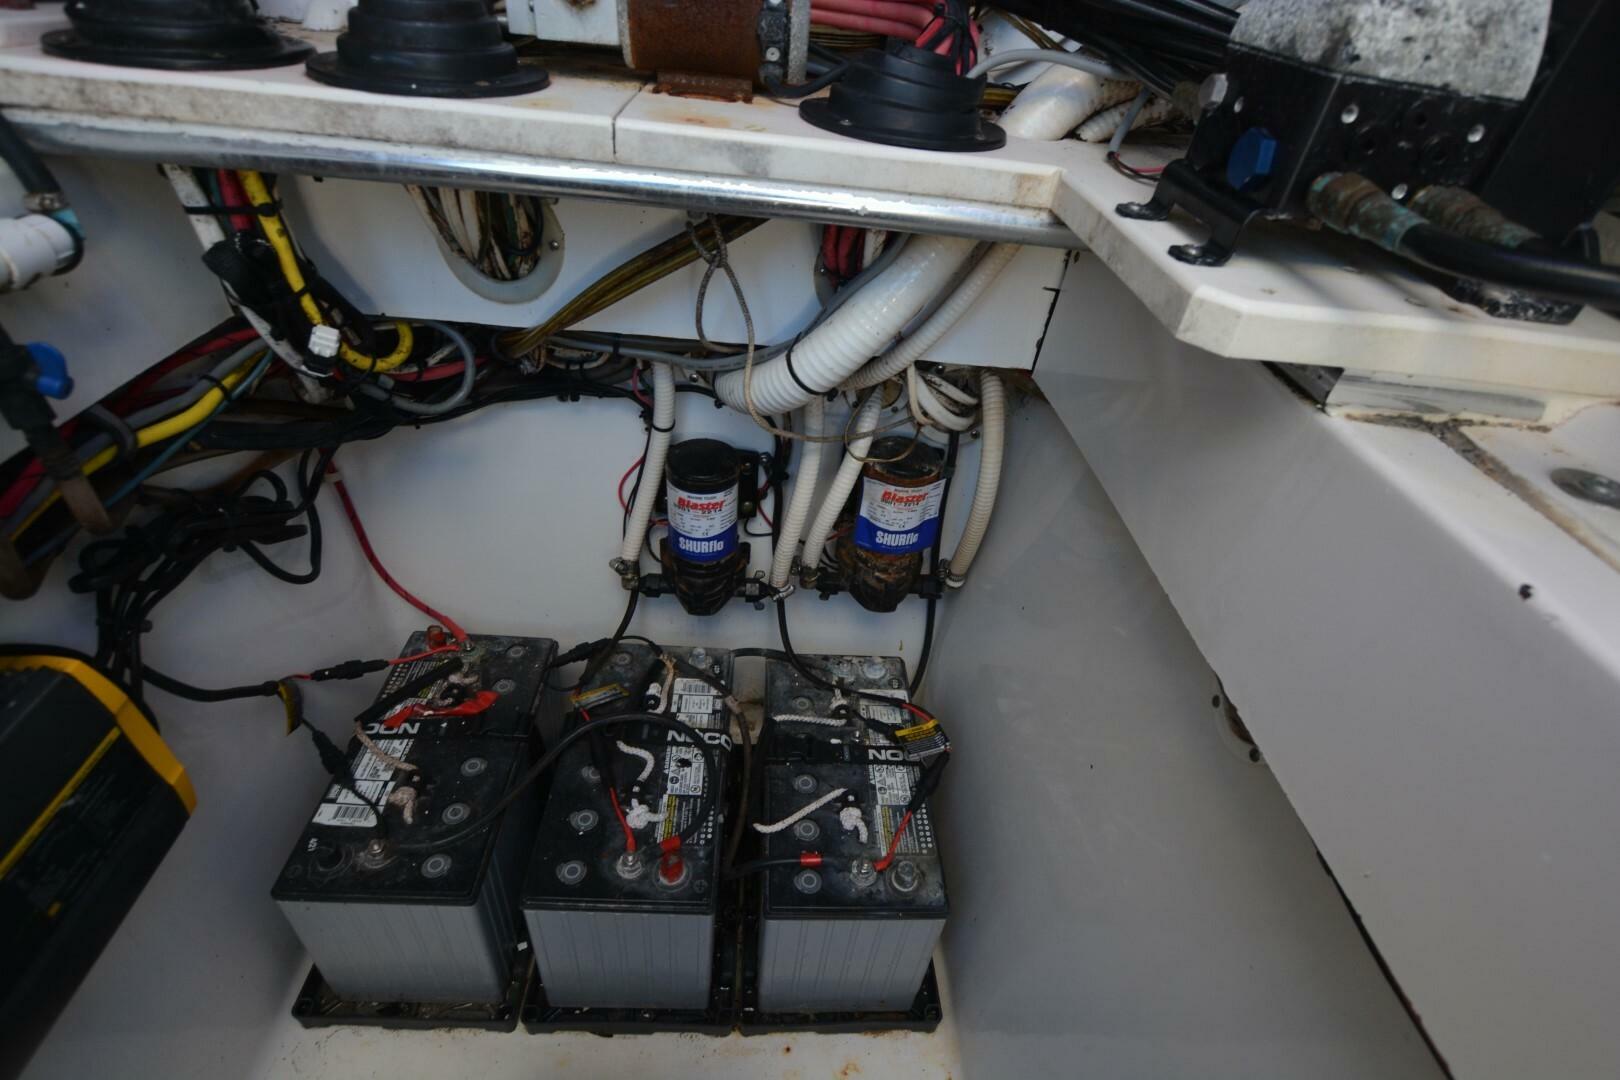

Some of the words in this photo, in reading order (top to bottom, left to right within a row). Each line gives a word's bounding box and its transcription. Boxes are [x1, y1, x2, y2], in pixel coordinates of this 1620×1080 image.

[678, 537, 724, 553] SHURflo
[876, 530, 919, 546] SHURflo
[364, 722, 421, 735] NOC
[667, 729, 732, 752] NCO
